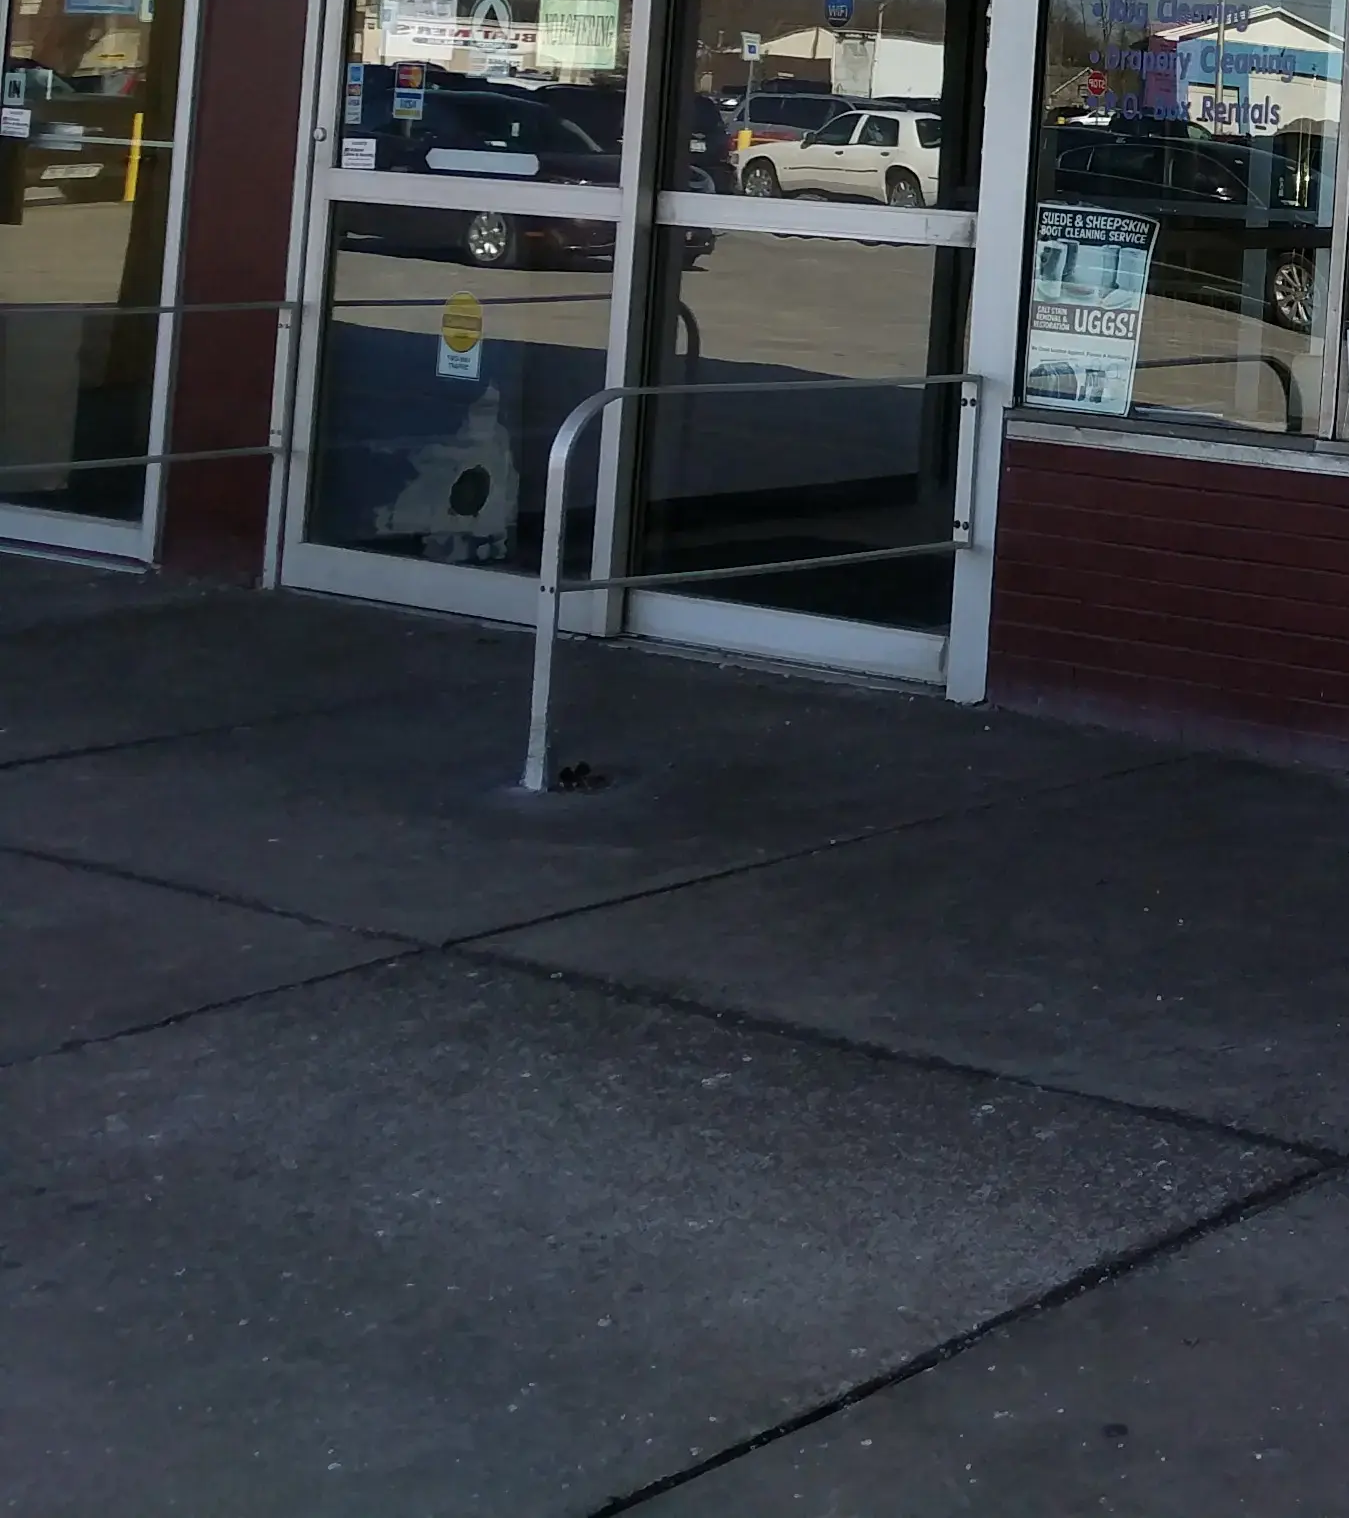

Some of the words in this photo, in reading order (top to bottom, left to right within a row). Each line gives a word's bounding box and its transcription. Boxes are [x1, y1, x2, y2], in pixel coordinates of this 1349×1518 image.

[1201, 45, 1297, 82] Cleaning
[1202, 96, 1281, 125] Rentals
[1040, 225, 1062, 237] BOOT
[1065, 228, 1106, 241] CLEANING
[1109, 231, 1147, 245] SERVICE
[1042, 211, 1073, 227] SUEDE
[1074, 214, 1083, 228] &
[1086, 215, 1150, 234] SHEEPSKIN
[1074, 308, 1135, 337] UGGS!
